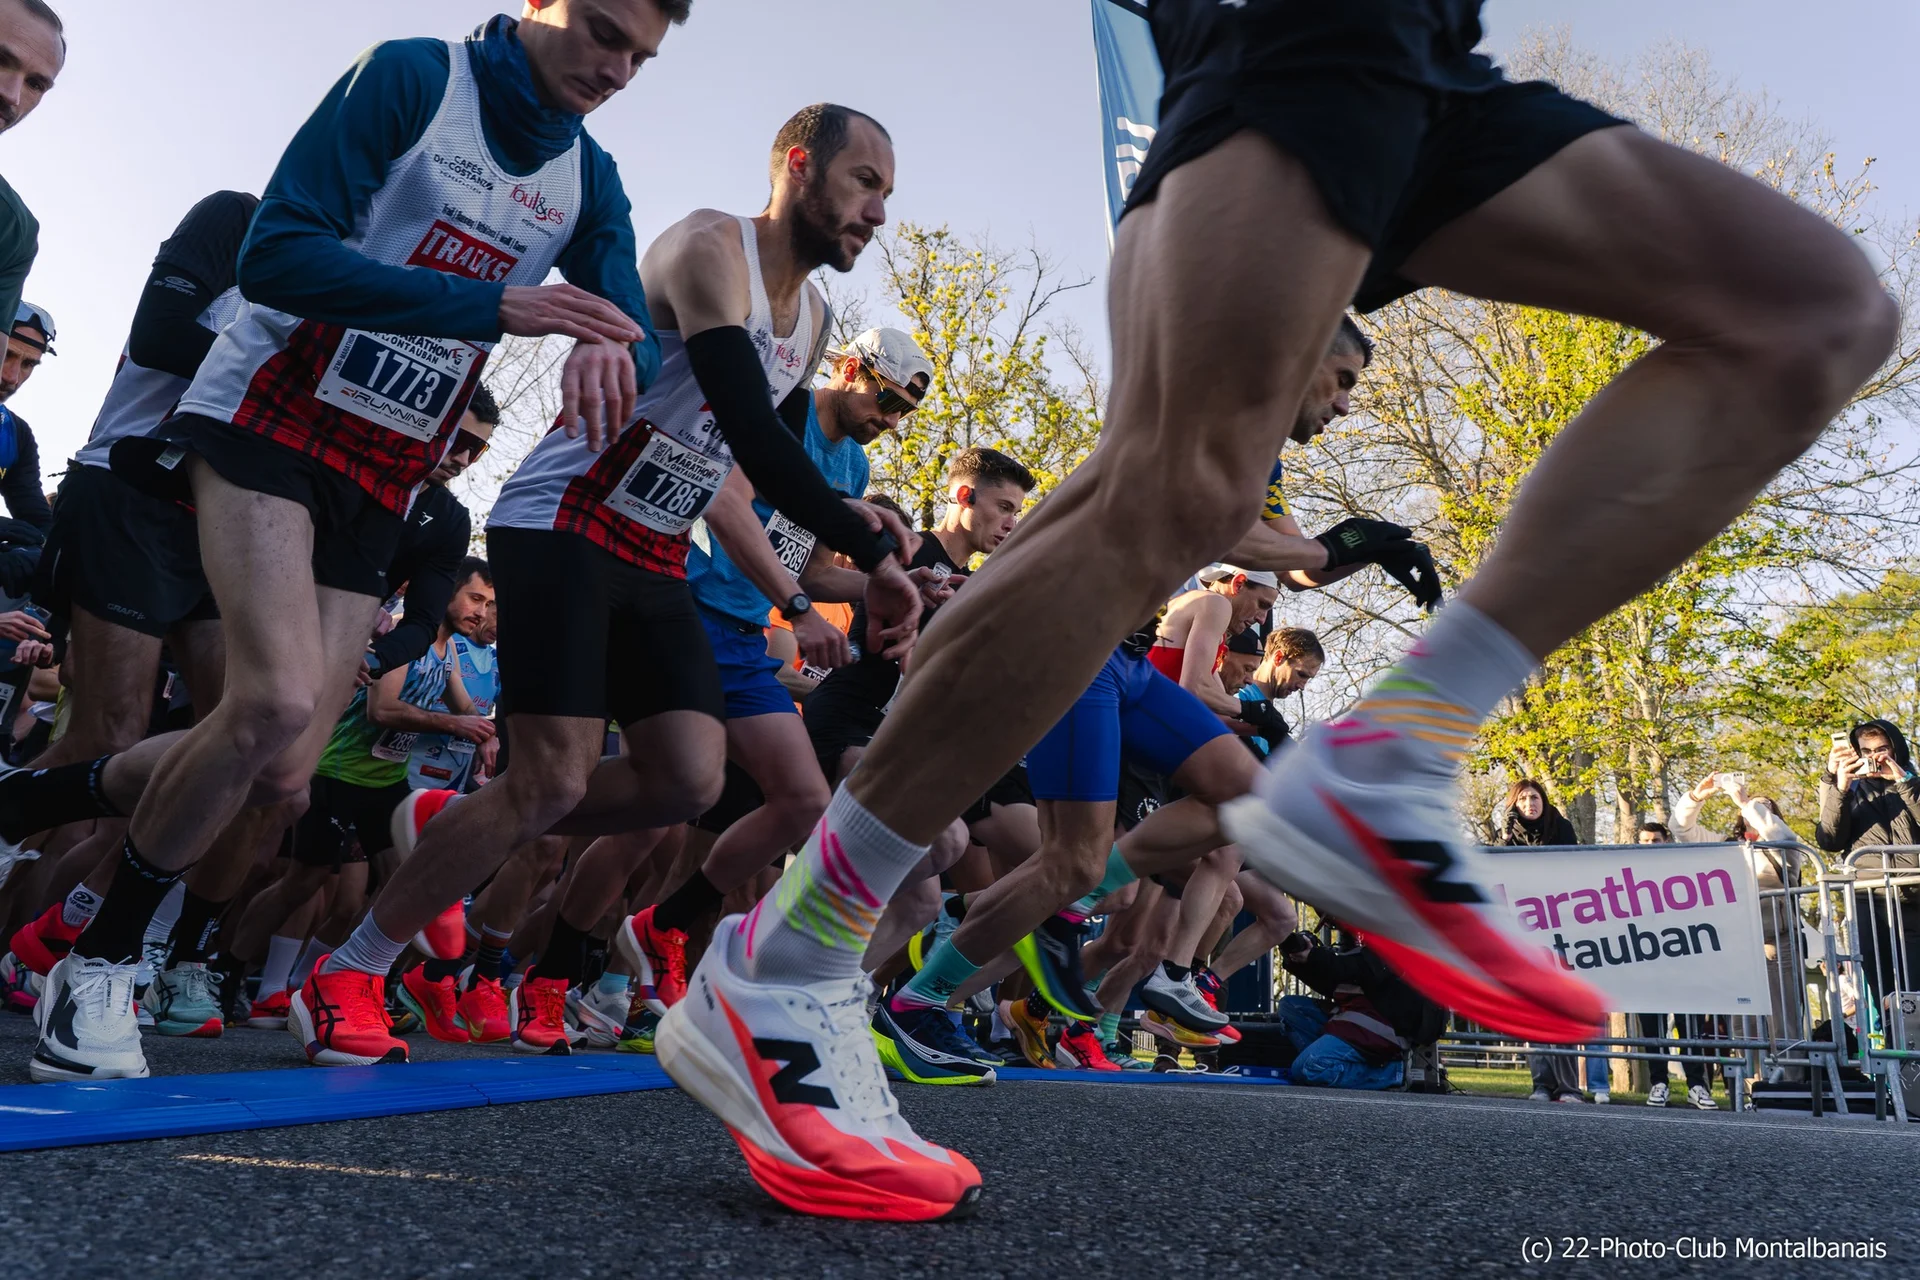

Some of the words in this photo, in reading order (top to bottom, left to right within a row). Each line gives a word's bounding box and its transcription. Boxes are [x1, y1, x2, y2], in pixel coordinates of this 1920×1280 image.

[454, 155, 484, 176] CAFÉS
[366, 348, 441, 410] 1773
[644, 472, 702, 516] 1786
[775, 536, 808, 571] 2889
[107, 602, 138, 617] CRAFT
[1494, 867, 1737, 932] arathon
[1547, 923, 1721, 972] tauban
